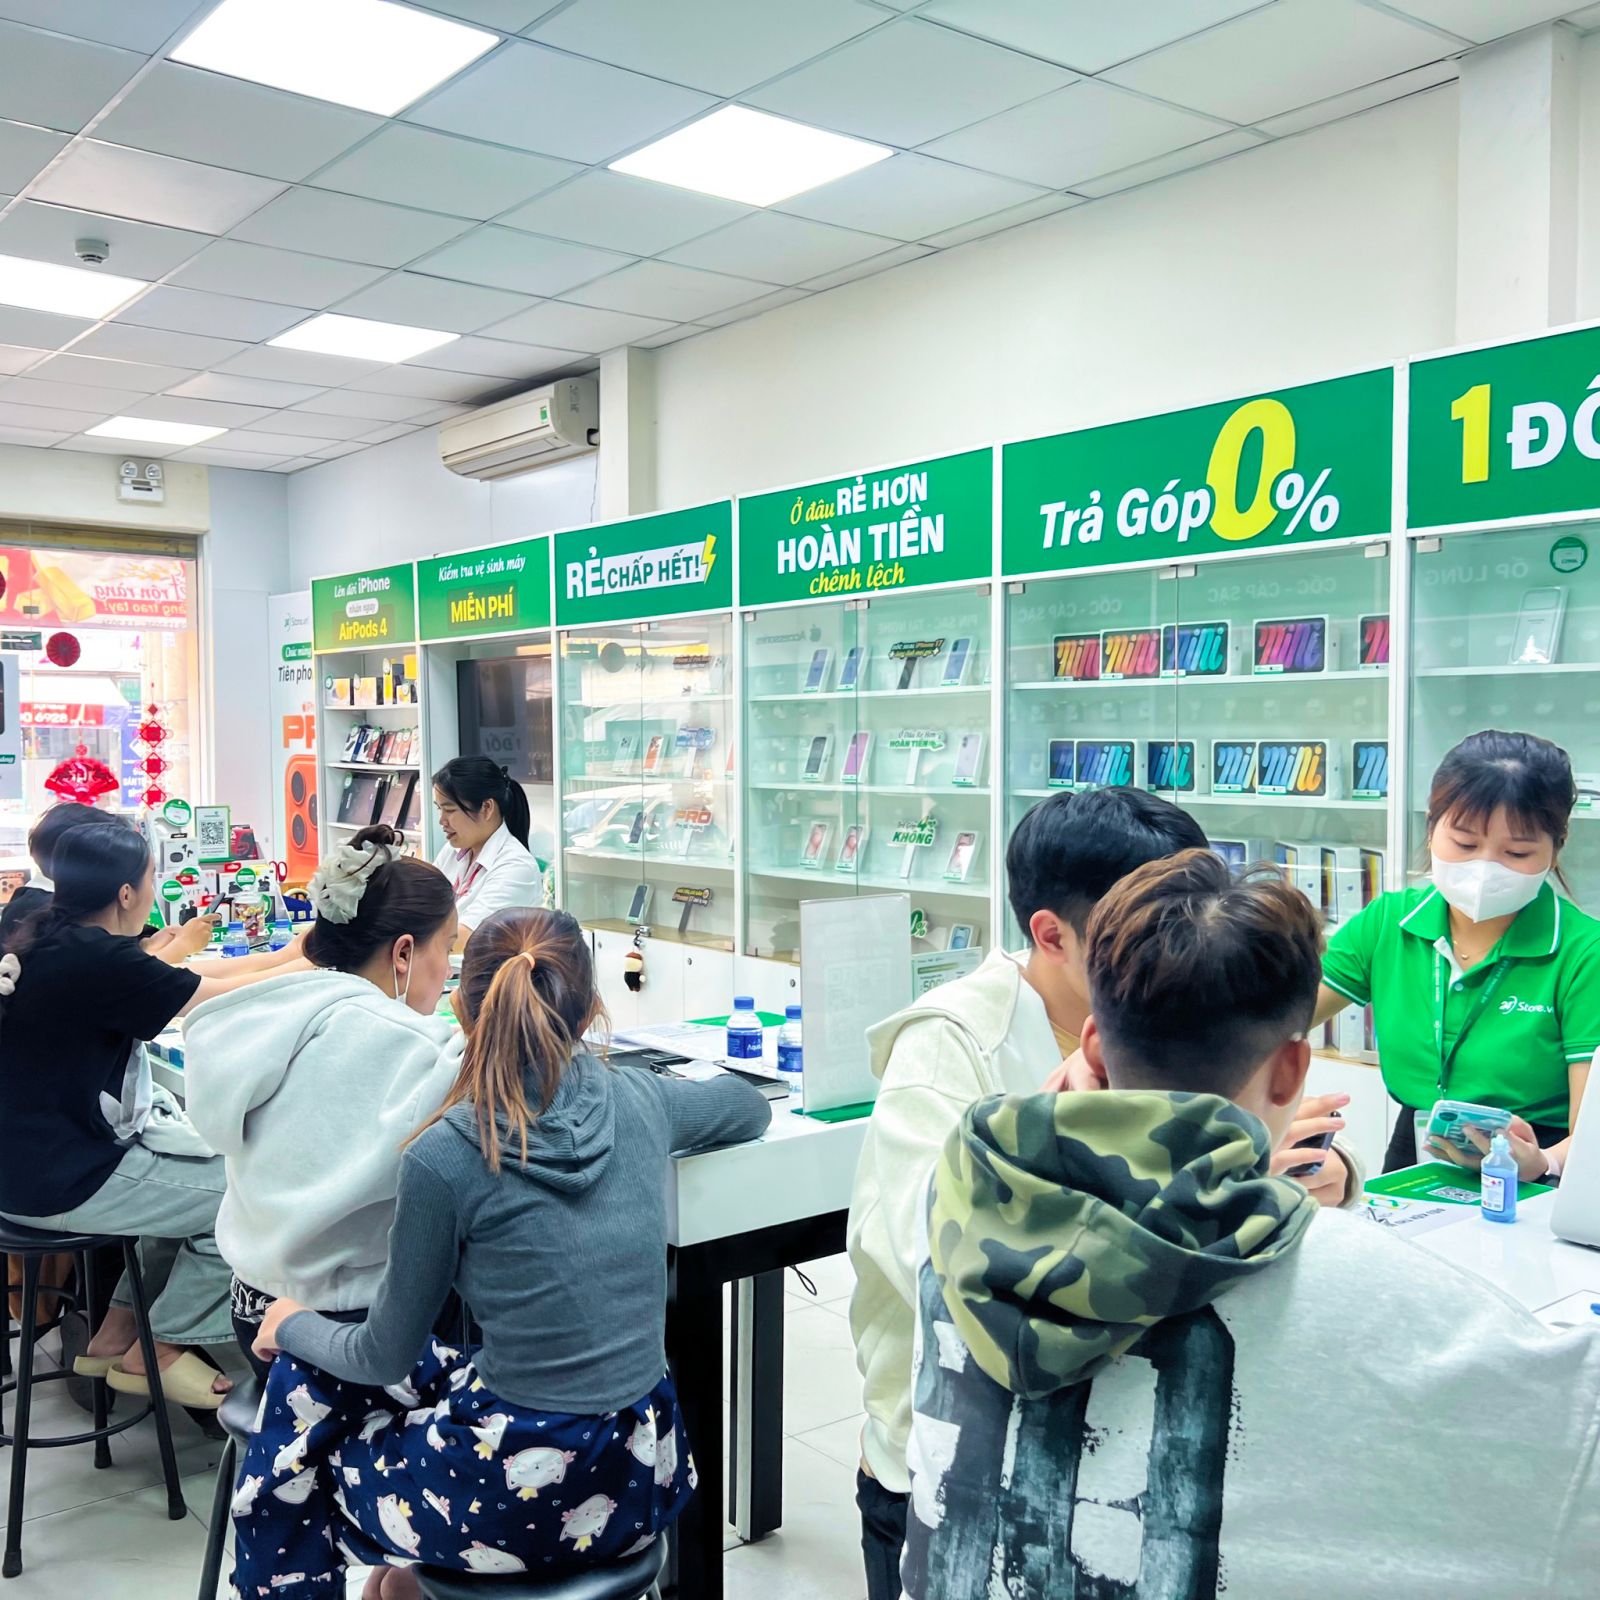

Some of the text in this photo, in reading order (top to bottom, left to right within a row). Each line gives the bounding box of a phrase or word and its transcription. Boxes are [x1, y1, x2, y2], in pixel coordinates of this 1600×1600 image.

[1450, 383, 1491, 485] 1
[789, 471, 928, 525] Ở đâu RẺ HƠN
[1039, 489, 1104, 549] Trả
[1116, 478, 1210, 543] Góp
[777, 504, 945, 575] HOÀN TIỀN
[460, 564, 474, 579] tra
[475, 560, 485, 578] vệ
[486, 557, 505, 574] sinh
[506, 553, 527, 572] máy
[566, 546, 700, 600] RẺ CHẤP HẾT!
[809, 562, 906, 595] chênh lệch
[358, 576, 391, 593] iPhone
[450, 586, 515, 624] MIỄN PHÍ
[339, 617, 388, 641] AirPods 4
[890, 738, 911, 748] HOÀN
[892, 830, 933, 845] KHÔNG
